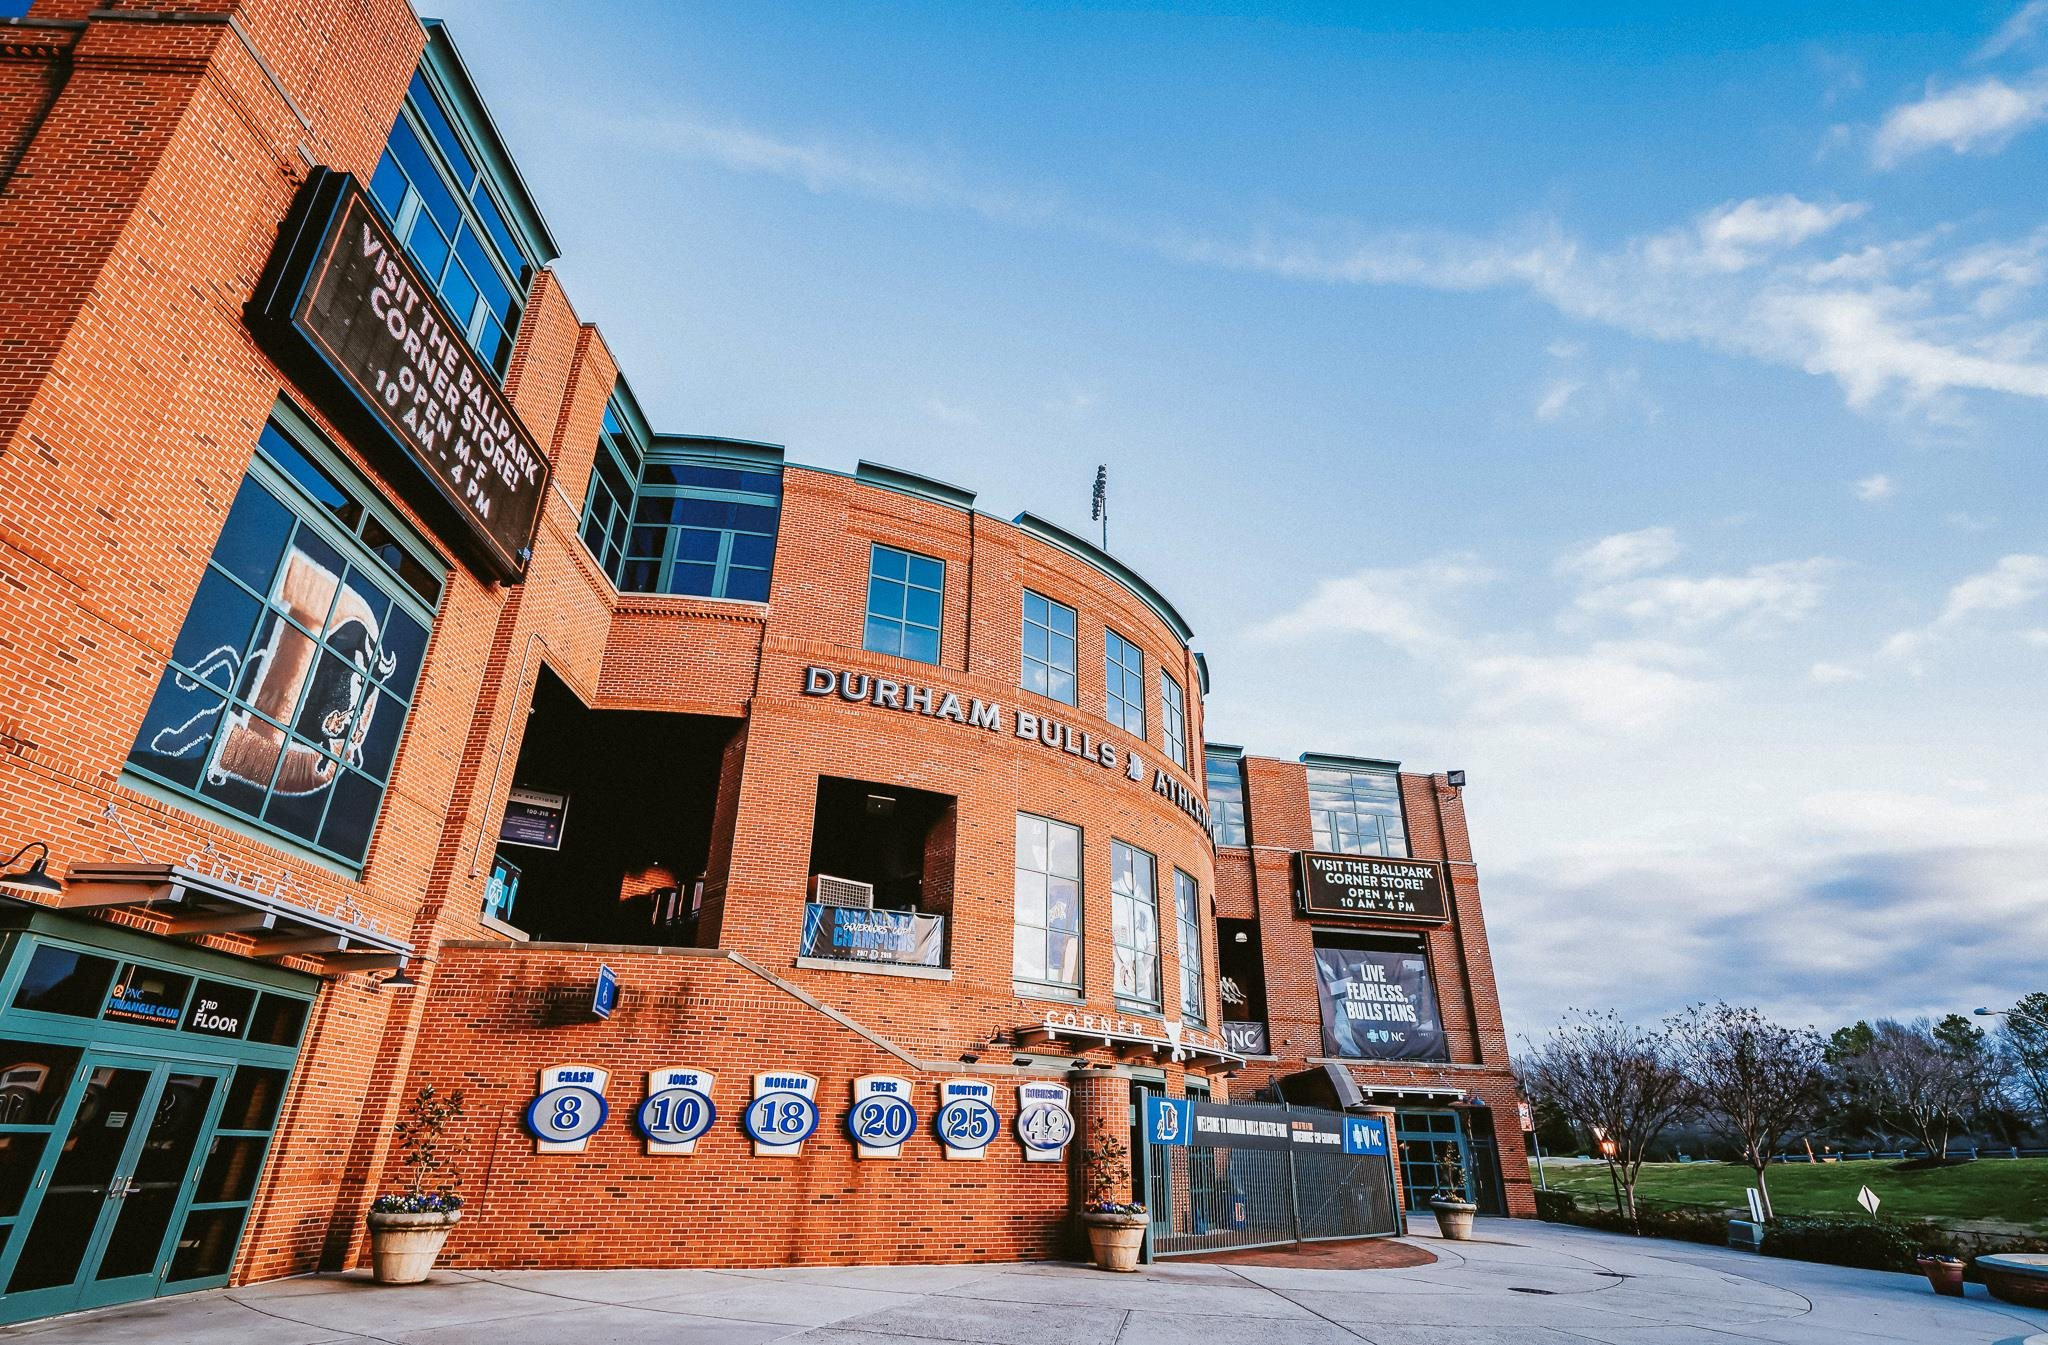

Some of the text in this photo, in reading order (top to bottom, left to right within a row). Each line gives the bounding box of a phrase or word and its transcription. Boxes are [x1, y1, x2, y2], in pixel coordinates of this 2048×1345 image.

[363, 222, 539, 486] VISIT THE BALLPARK
[370, 286, 519, 492] CORNER STORE!
[399, 365, 488, 480] OPEN M-F
[376, 369, 399, 406] 10
[402, 406, 435, 452] AM
[451, 464, 463, 484] 4
[466, 477, 491, 519] PM
[804, 665, 1001, 733] DURHAM
[1015, 709, 1118, 770] BULLS
[1312, 859, 1434, 879] VISIT THE BALLPARK
[1325, 872, 1424, 891] CORNER STORE!
[1340, 897, 1354, 908] 10
[1357, 899, 1376, 909] AM
[1387, 901, 1395, 911] 4
[1397, 901, 1415, 912] PM
[1348, 888, 1405, 901] OPEN M-F
[1360, 964, 1387, 982] LIVE
[125, 987, 145, 1000] PNC
[1346, 982, 1409, 1004] FEARLESS,
[108, 999, 180, 1019] TRIANGLE CLUB
[198, 999, 218, 1013] 3RD
[1345, 1001, 1417, 1022] BULLS FANS
[192, 1012, 238, 1032] FLOOR
[1046, 1010, 1144, 1037] CORNER
[1230, 1029, 1257, 1048] NC
[1390, 1031, 1406, 1042] NC
[557, 1071, 594, 1083] CRASH
[667, 1074, 698, 1086] JONES
[764, 1076, 808, 1089] MORGAN
[870, 1081, 898, 1092] EVERS
[948, 1084, 988, 1096] MONTOYO
[551, 1094, 583, 1131] 8
[651, 1096, 701, 1134] 10
[760, 1100, 805, 1133] 18
[861, 1103, 908, 1138] 20
[948, 1107, 988, 1139] 25
[1027, 1109, 1066, 1141] 42
[1370, 1129, 1382, 1147] NC
